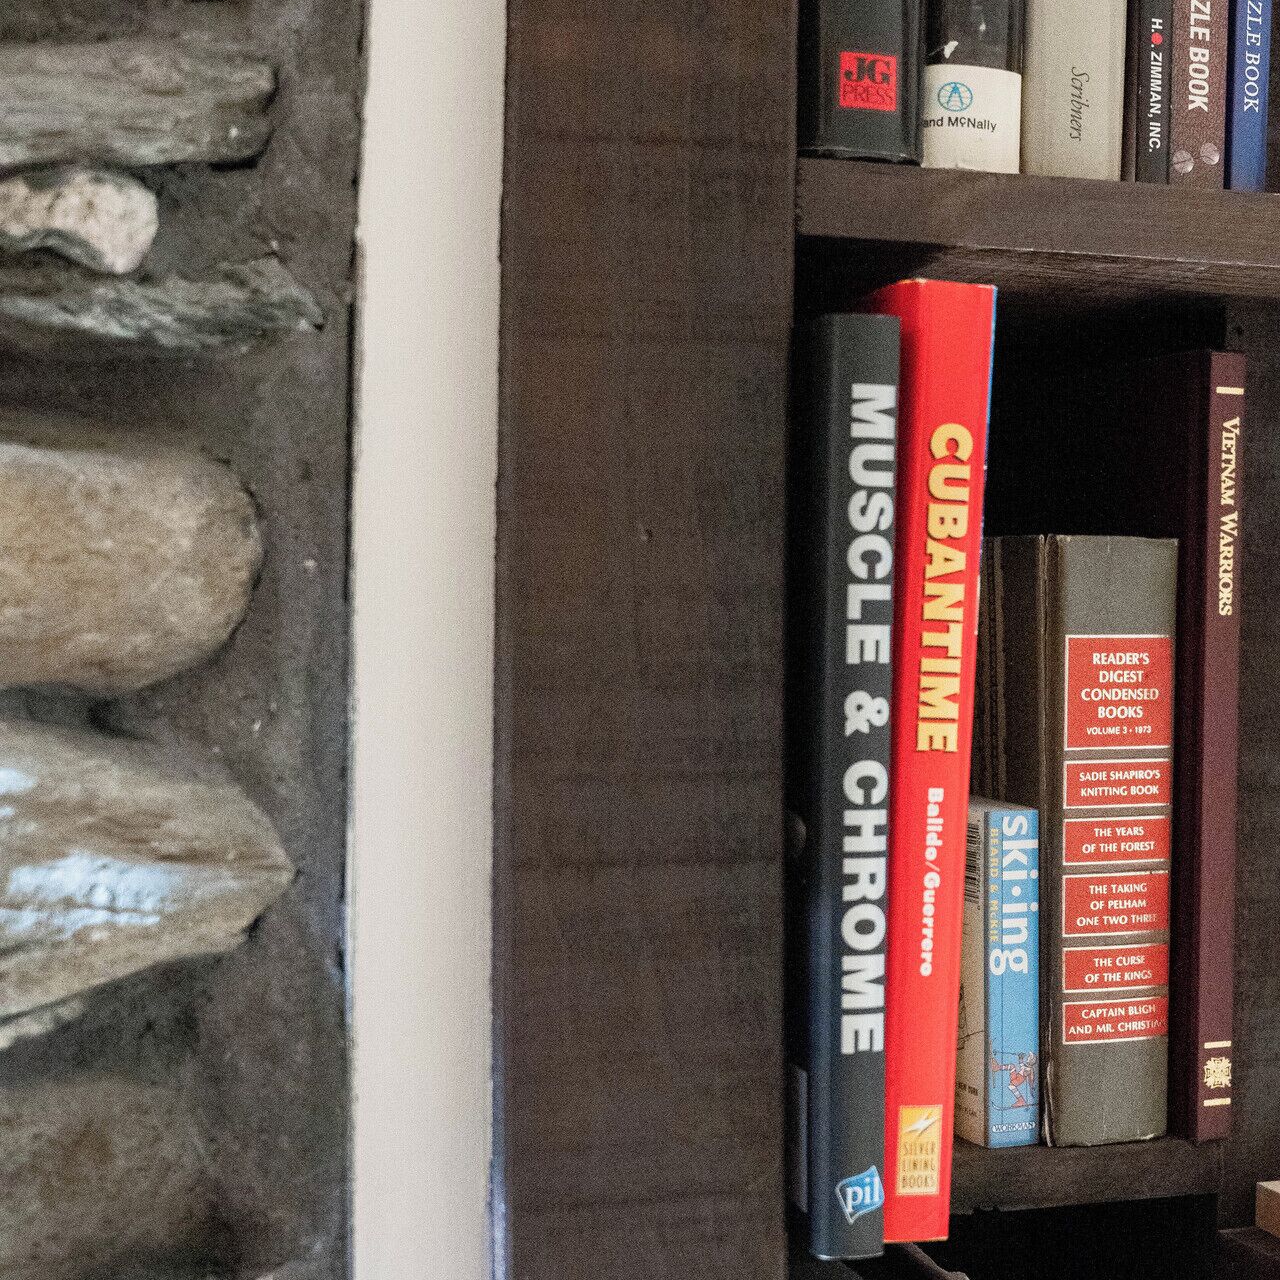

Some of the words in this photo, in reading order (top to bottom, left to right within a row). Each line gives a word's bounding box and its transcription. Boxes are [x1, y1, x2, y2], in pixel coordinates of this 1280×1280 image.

[845, 58, 890, 86] JG
[1148, 51, 1162, 123] ZIMMAN,
[1188, 47, 1210, 113] BOOK
[1243, 50, 1260, 112] BOOK
[842, 85, 894, 104] PRESS
[1069, 67, 1092, 143] Scribners
[923, 117, 943, 129] and
[947, 117, 997, 133] McNally
[1148, 126, 1161, 153] INC.
[1220, 416, 1240, 505] VIETNAM
[845, 383, 898, 665] MUSCLE
[1218, 510, 1239, 617] WARRIORS
[916, 423, 973, 753] CUBANTIME
[1092, 652, 1150, 665] READER'S
[1099, 670, 1144, 683] DIGEST
[1081, 688, 1159, 701] CONDENSED
[844, 691, 889, 737] &
[1097, 706, 1143, 719] BOOKS
[1086, 726, 1120, 735] VOLUME
[1122, 726, 1128, 734] 3
[1134, 726, 1152, 734] 1973
[1079, 772, 1107, 781] SADIE
[1110, 770, 1160, 780] SHAPIRO'S
[1081, 786, 1127, 797] KNITTING
[1130, 785, 1159, 795] BOOK
[1094, 828, 1112, 837] THE
[1115, 827, 1144, 836] YEARS
[1082, 844, 1096, 854] OF
[1099, 843, 1117, 852] THE
[1120, 841, 1155, 852] FOREST
[920, 787, 944, 977] Balido/Guerrero
[1089, 885, 1107, 894] THE
[1111, 883, 1147, 893] TAKING
[840, 759, 888, 1056] CHROME
[1090, 901, 1104, 910] OF
[1108, 899, 1146, 909] PELHAM
[1076, 916, 1099, 926] ONE
[1103, 915, 1128, 925] TWO
[1094, 958, 1112, 967] THE
[1116, 956, 1145, 965] CURSE
[1085, 974, 1099, 983] OF
[1103, 972, 1121, 982] THE
[1124, 970, 1152, 980] KINGS
[1081, 1007, 1125, 1019] CAPTAIN
[1128, 1004, 1156, 1015] BLIGH
[1068, 1024, 1092, 1035] AND
[1096, 1023, 1114, 1033] MR.
[846, 1176, 880, 1213] pil
